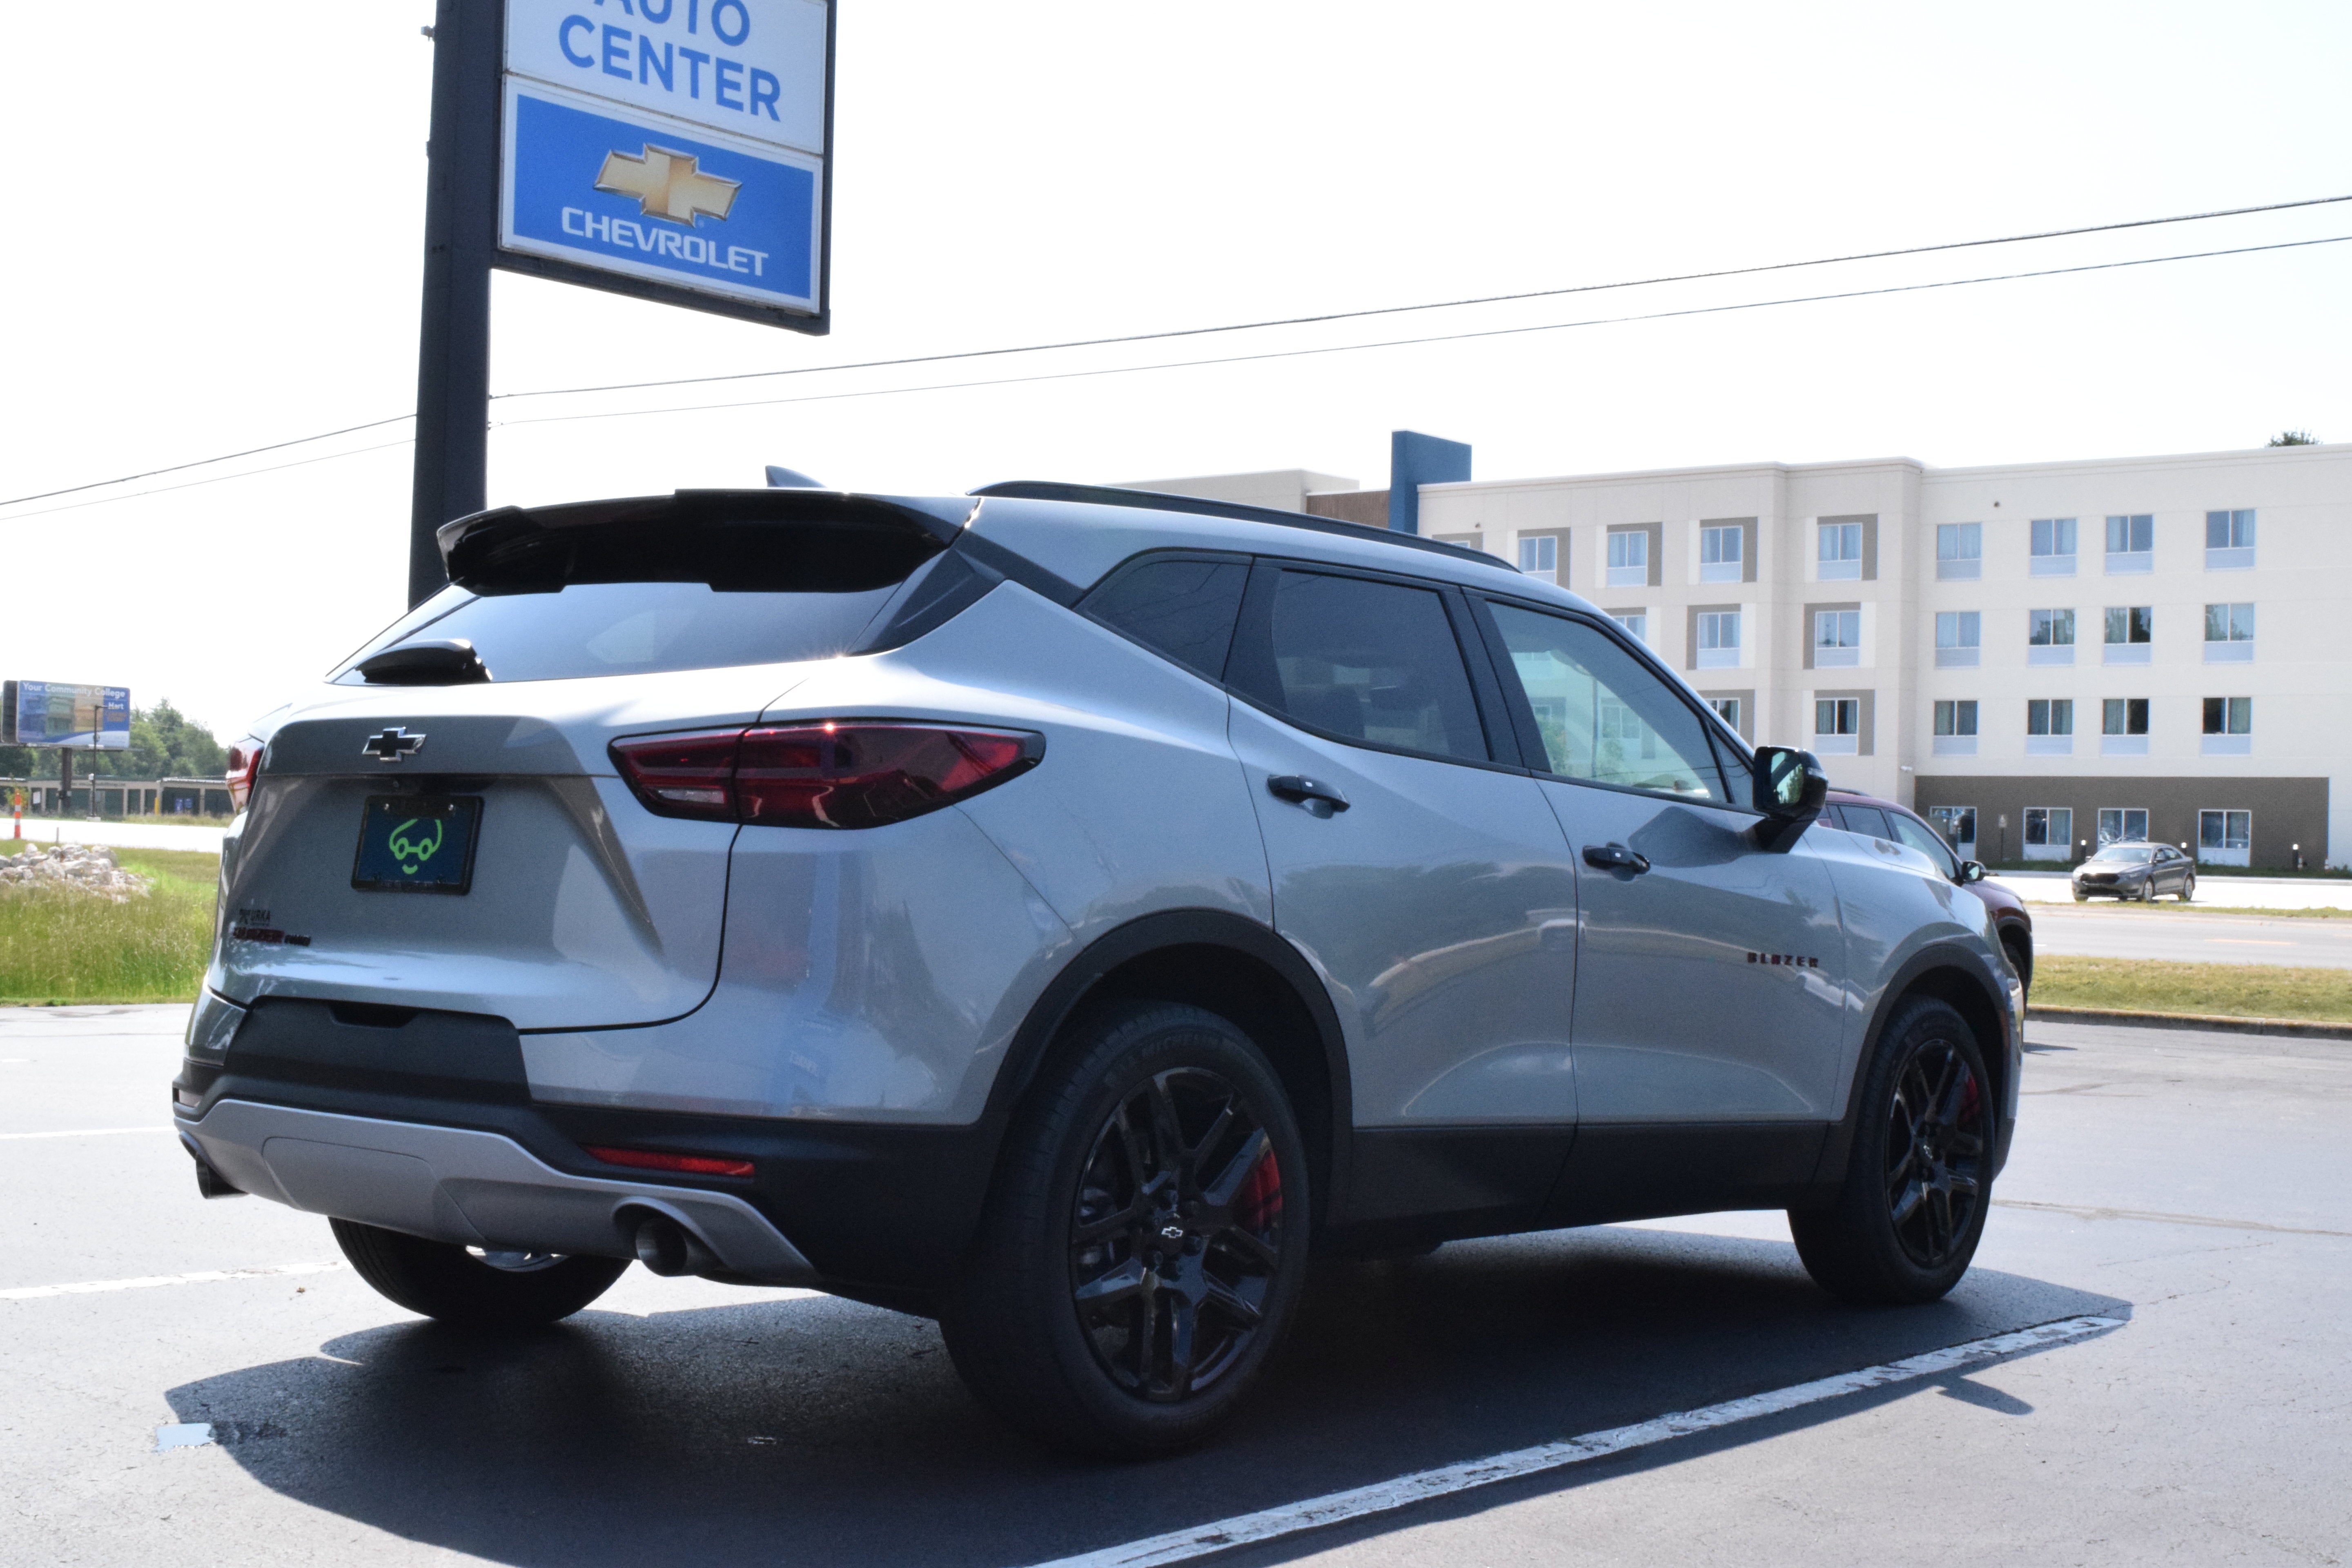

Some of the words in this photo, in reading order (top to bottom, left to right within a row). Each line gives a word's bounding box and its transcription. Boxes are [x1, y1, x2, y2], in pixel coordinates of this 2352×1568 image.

[594, 0, 750, 47] UTO
[558, 14, 781, 122] CENTER
[561, 206, 769, 276] CHEVROLET
[22, 682, 42, 691] Your
[45, 684, 92, 697] Community
[94, 688, 125, 699] College
[1747, 952, 1818, 968] BLAZER
